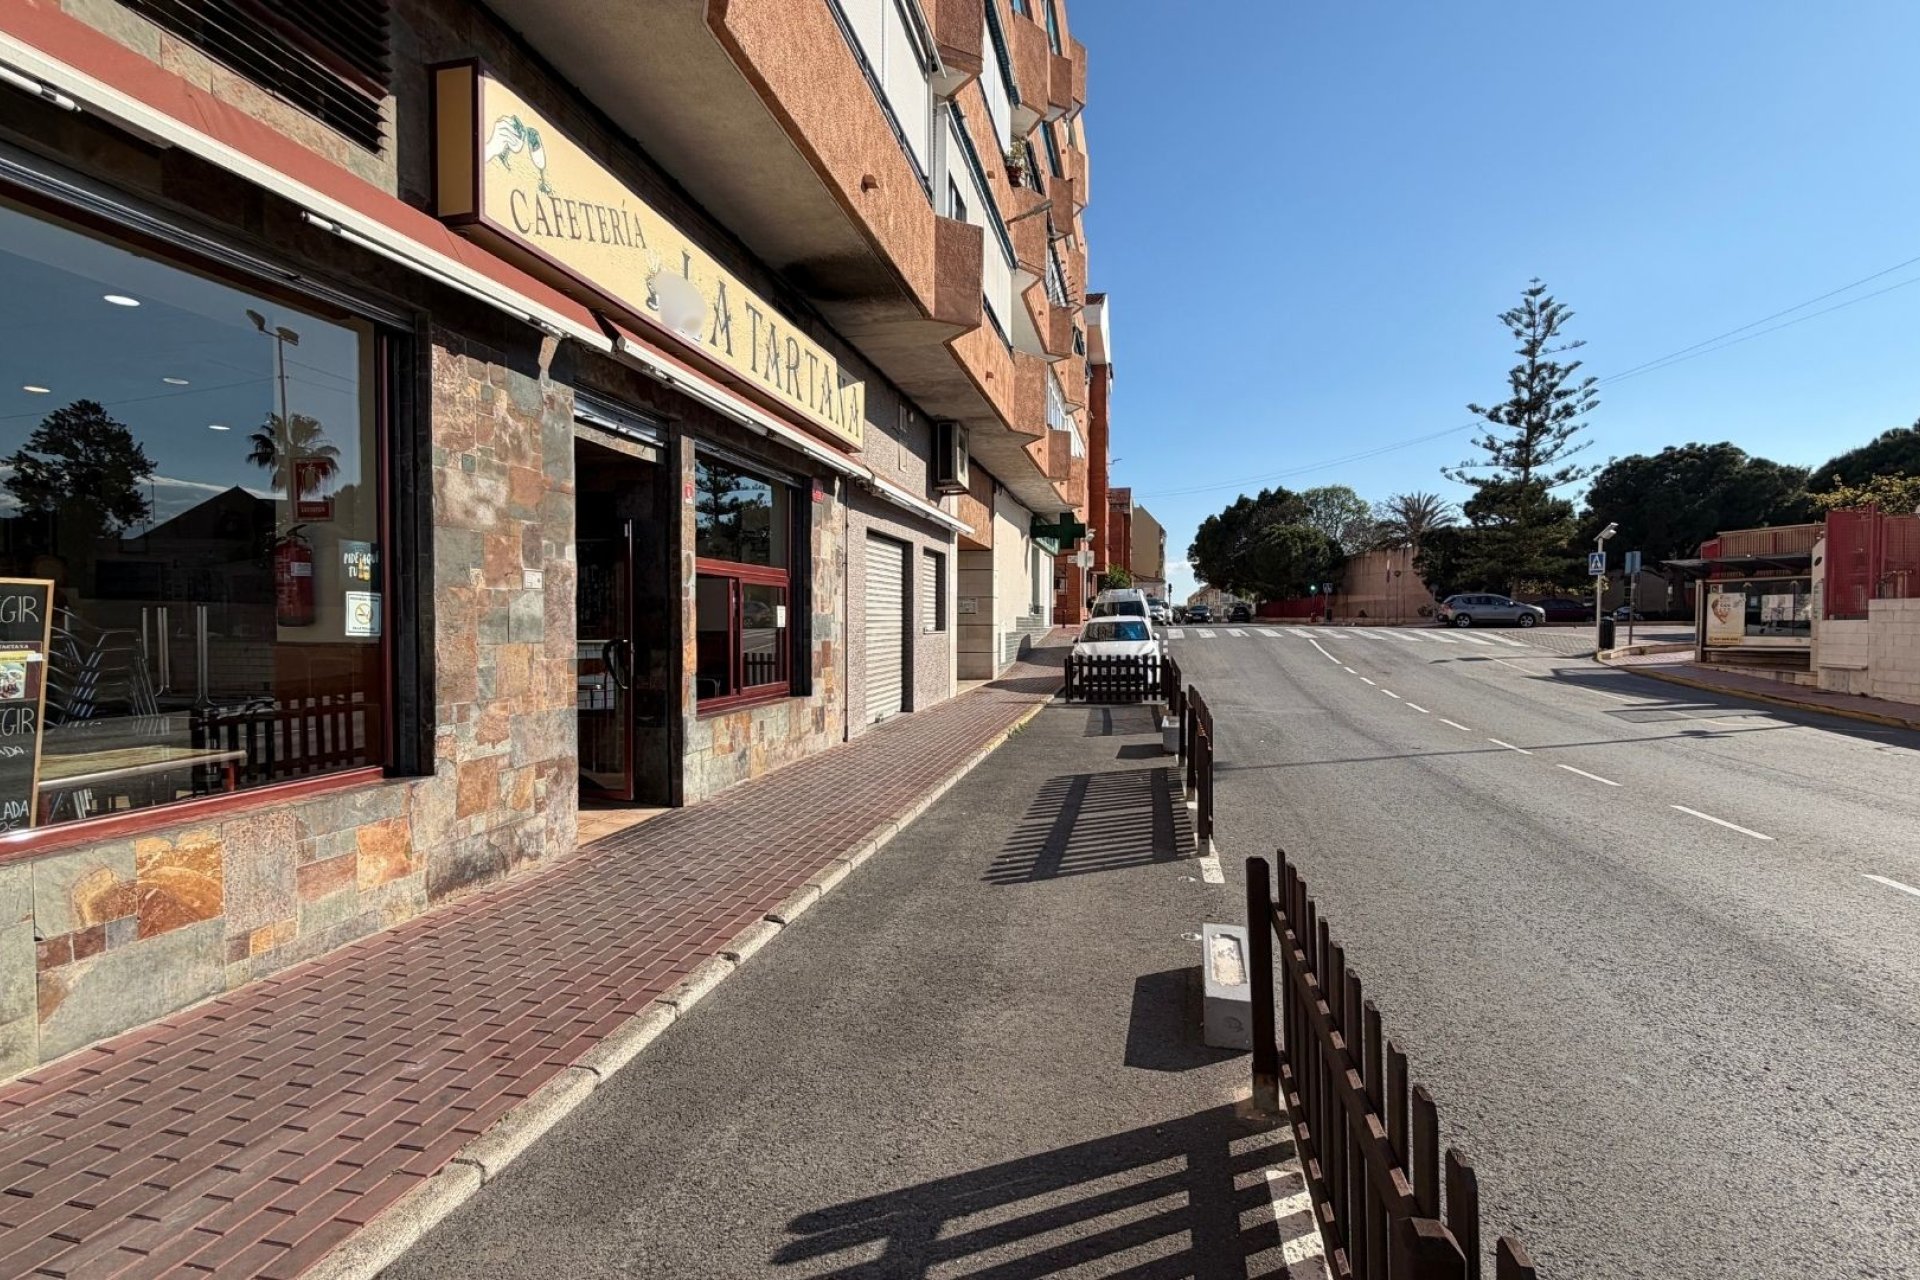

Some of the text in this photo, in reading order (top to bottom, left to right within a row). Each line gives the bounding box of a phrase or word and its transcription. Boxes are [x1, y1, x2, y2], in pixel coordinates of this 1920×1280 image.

[510, 188, 648, 250] CAFETERÍA
[745, 300, 860, 438] TARTANA
[0, 595, 40, 623] GIR
